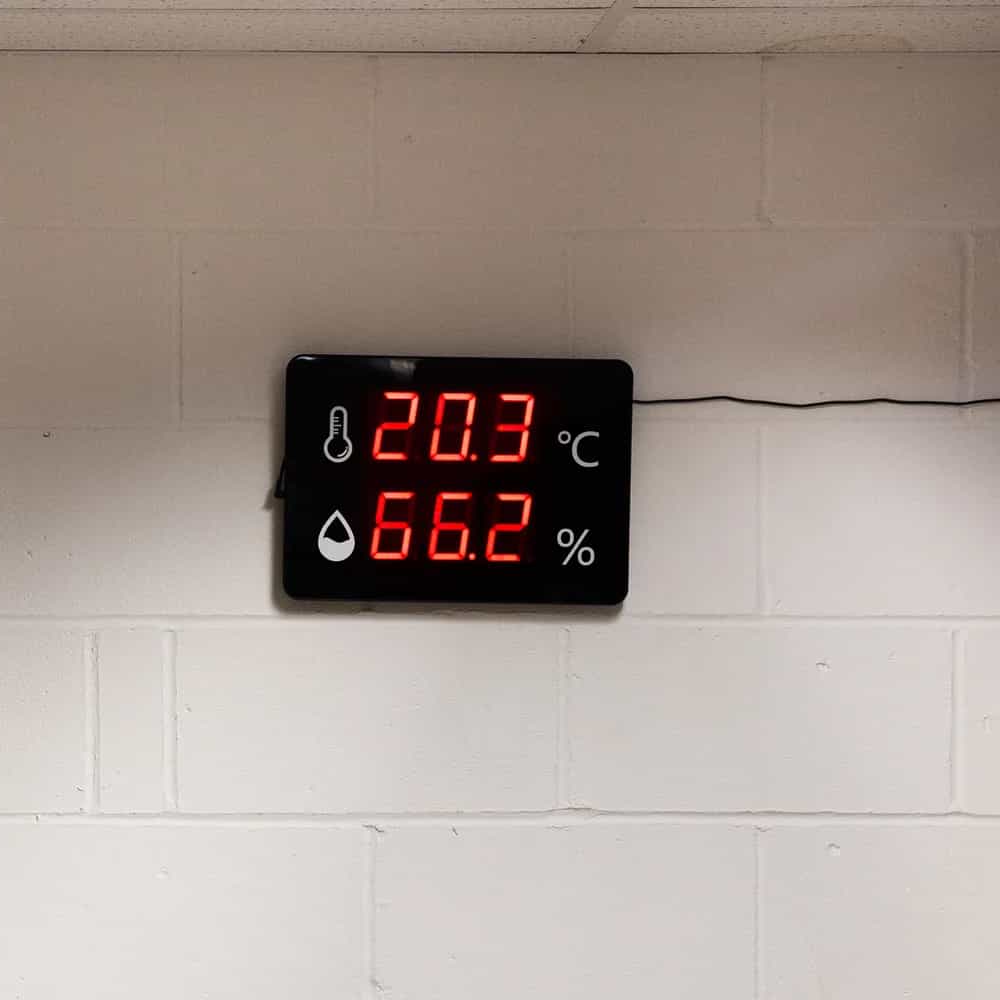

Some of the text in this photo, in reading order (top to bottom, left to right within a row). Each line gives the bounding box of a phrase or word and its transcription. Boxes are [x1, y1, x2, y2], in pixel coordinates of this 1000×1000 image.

[371, 391, 600, 468] 20.3 °C
[369, 491, 596, 566] 66.2 %
